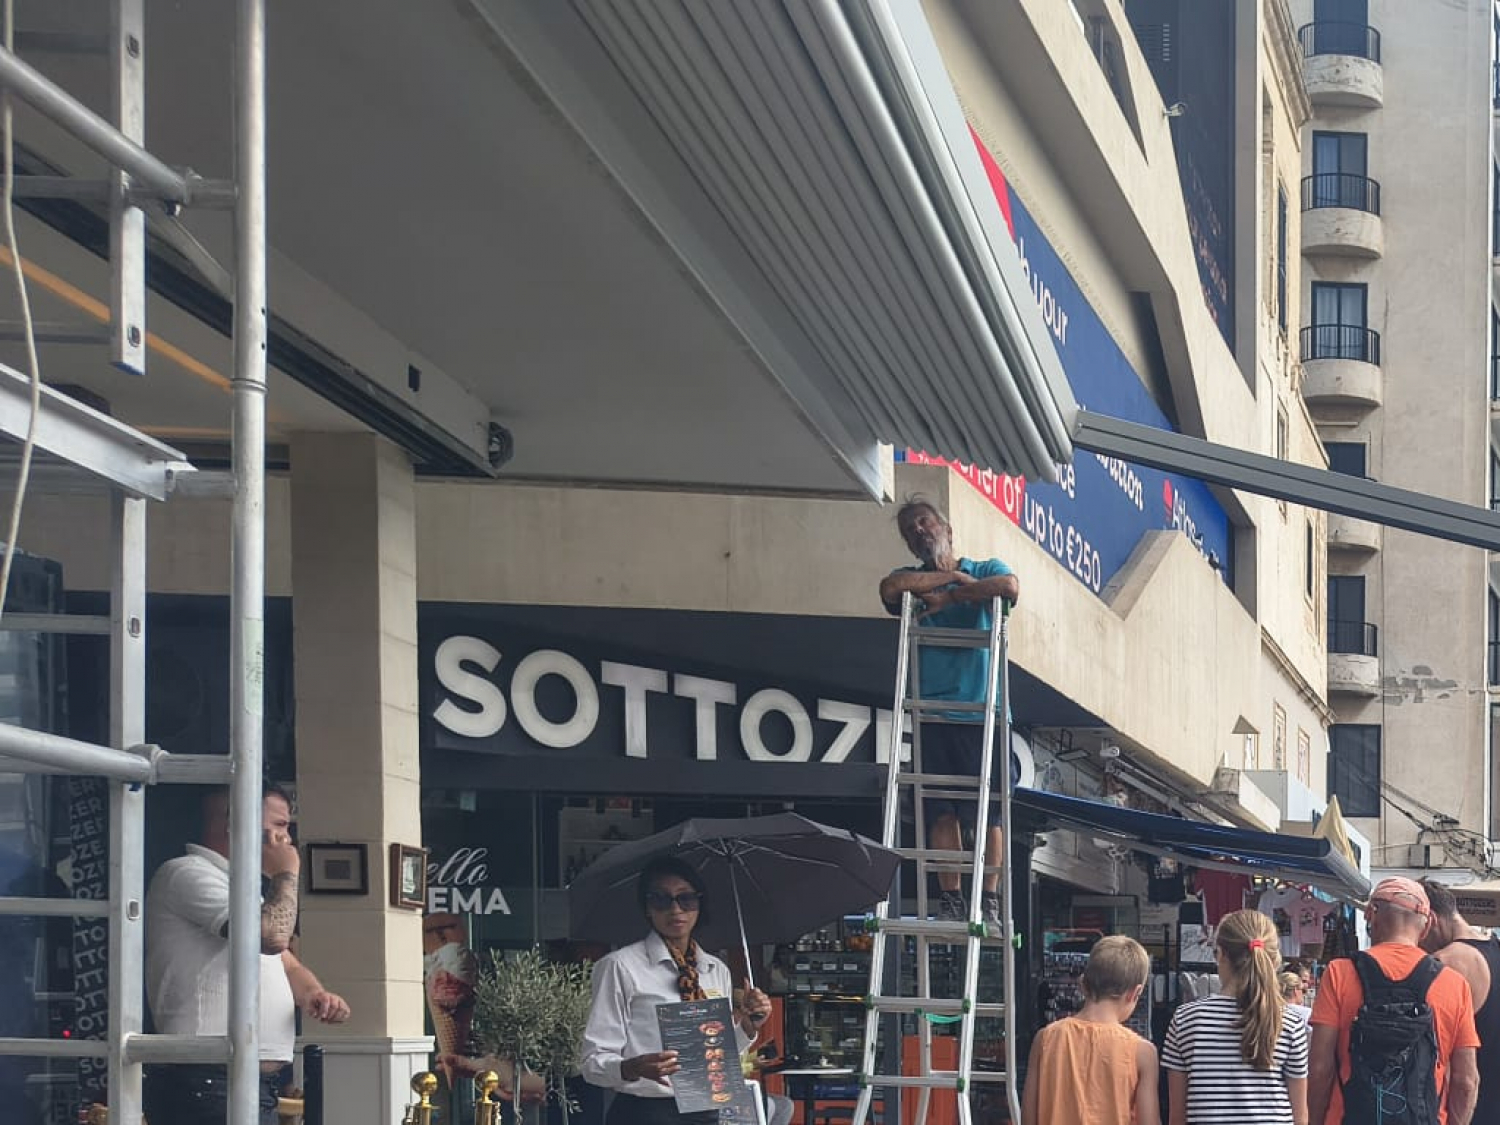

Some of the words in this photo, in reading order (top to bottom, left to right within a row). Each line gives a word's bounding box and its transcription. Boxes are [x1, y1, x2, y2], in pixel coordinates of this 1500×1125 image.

[1024, 491, 1046, 545] up
[1048, 505, 1064, 559] to
[1066, 525, 1101, 594] €250
[432, 635, 1036, 790] SOTTOZE
[427, 847, 489, 886] ello
[427, 887, 513, 916] EMA
